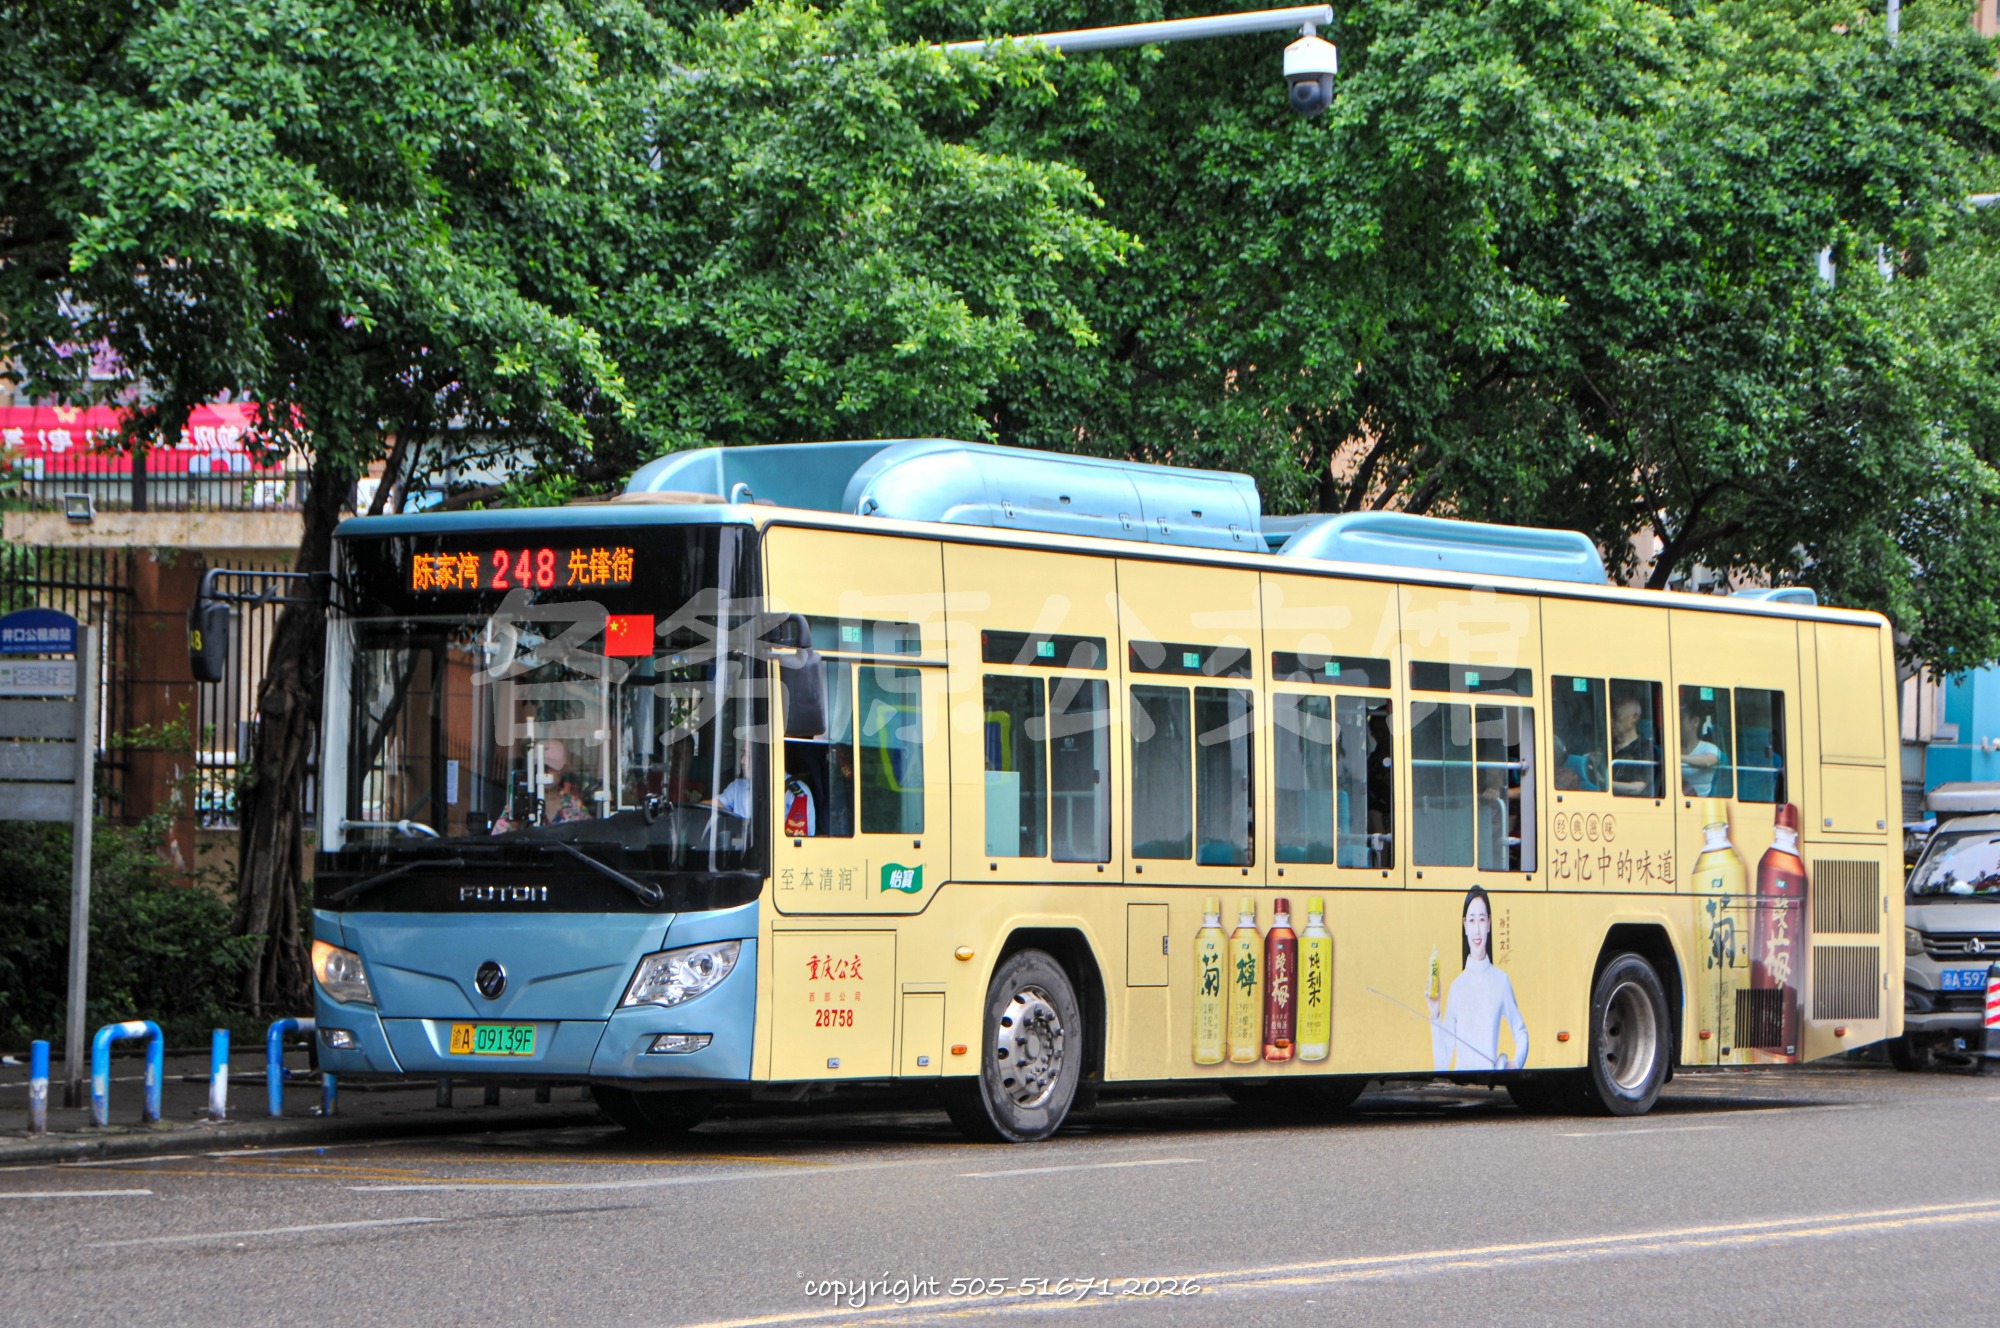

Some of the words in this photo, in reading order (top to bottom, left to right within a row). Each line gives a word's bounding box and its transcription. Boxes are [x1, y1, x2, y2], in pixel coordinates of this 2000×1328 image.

[412, 552, 479, 590] 陈家湾
[492, 548, 555, 590] 248
[567, 547, 635, 586] 先锋街
[1555, 815, 1614, 839] 经典滋味
[1552, 846, 1675, 886] 记忆中的味道
[460, 885, 547, 901] FOTON
[806, 954, 864, 981] 重庆公交
[815, 1008, 854, 1027] 28758
[478, 1028, 533, 1051] 09139F
